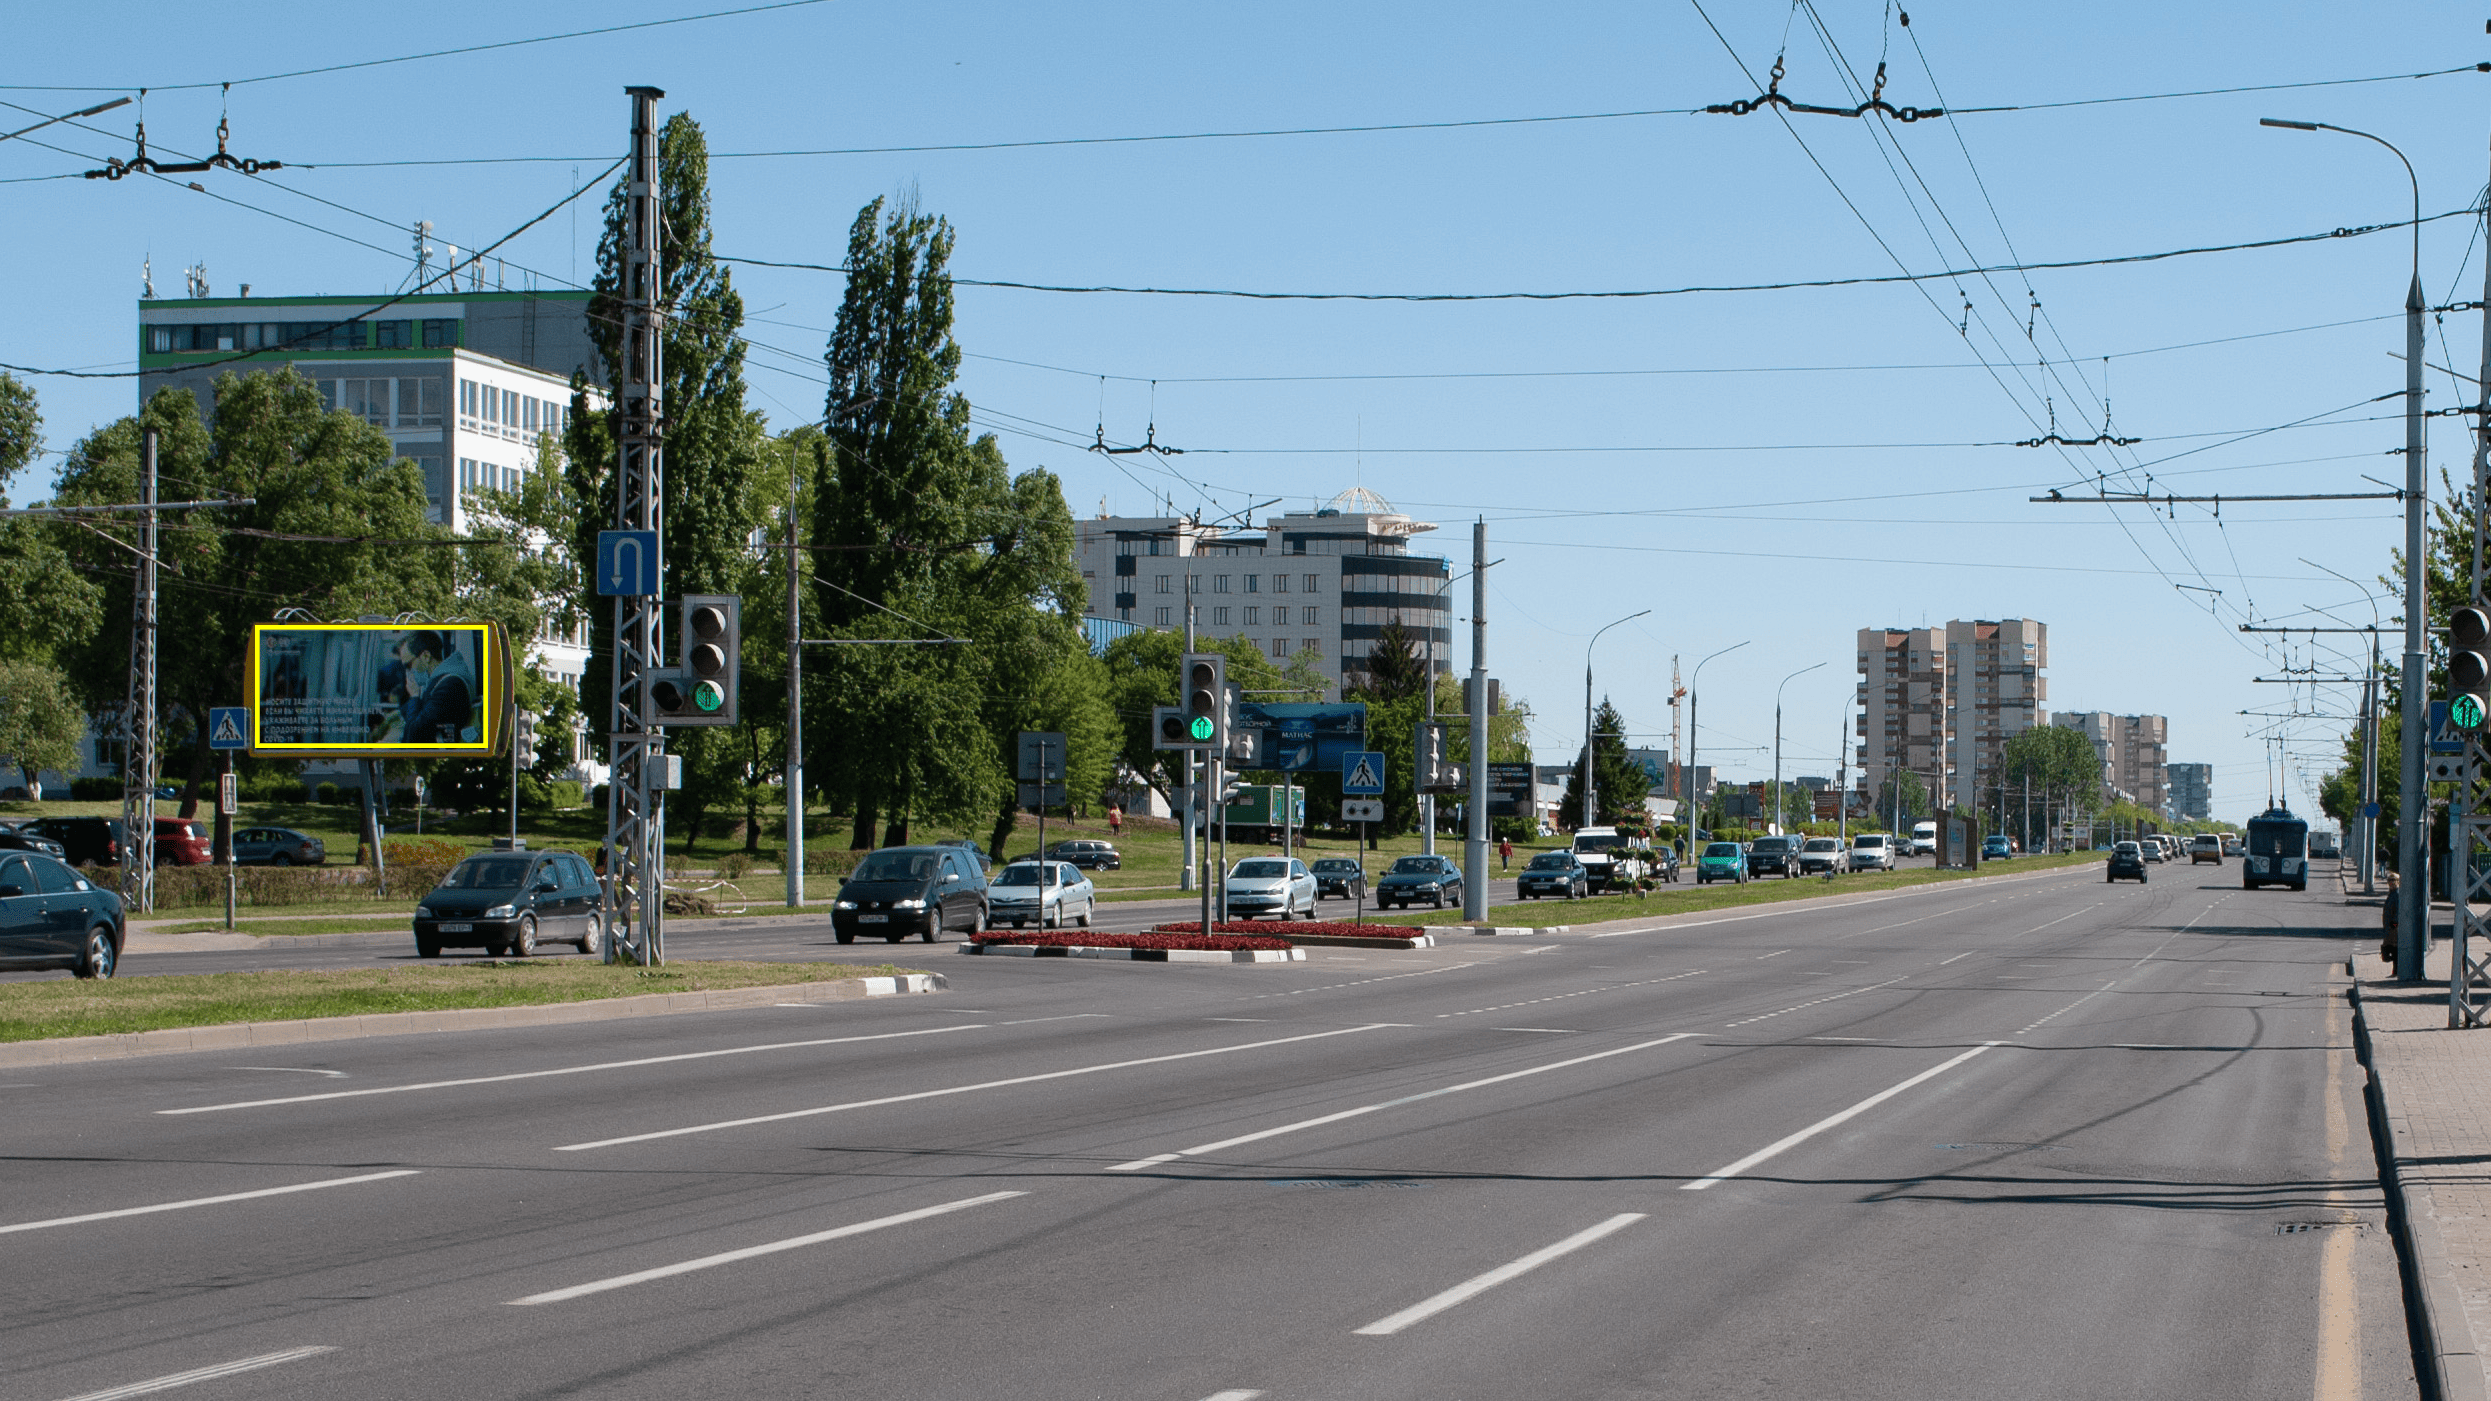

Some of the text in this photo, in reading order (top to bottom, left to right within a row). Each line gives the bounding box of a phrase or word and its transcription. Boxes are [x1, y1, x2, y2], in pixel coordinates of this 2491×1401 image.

[320, 716, 352, 724] БОЛЬНЫМ
[270, 726, 319, 734] ПОДОЗРЕНИЕМ
[1281, 731, 1313, 739] МАТИАС
